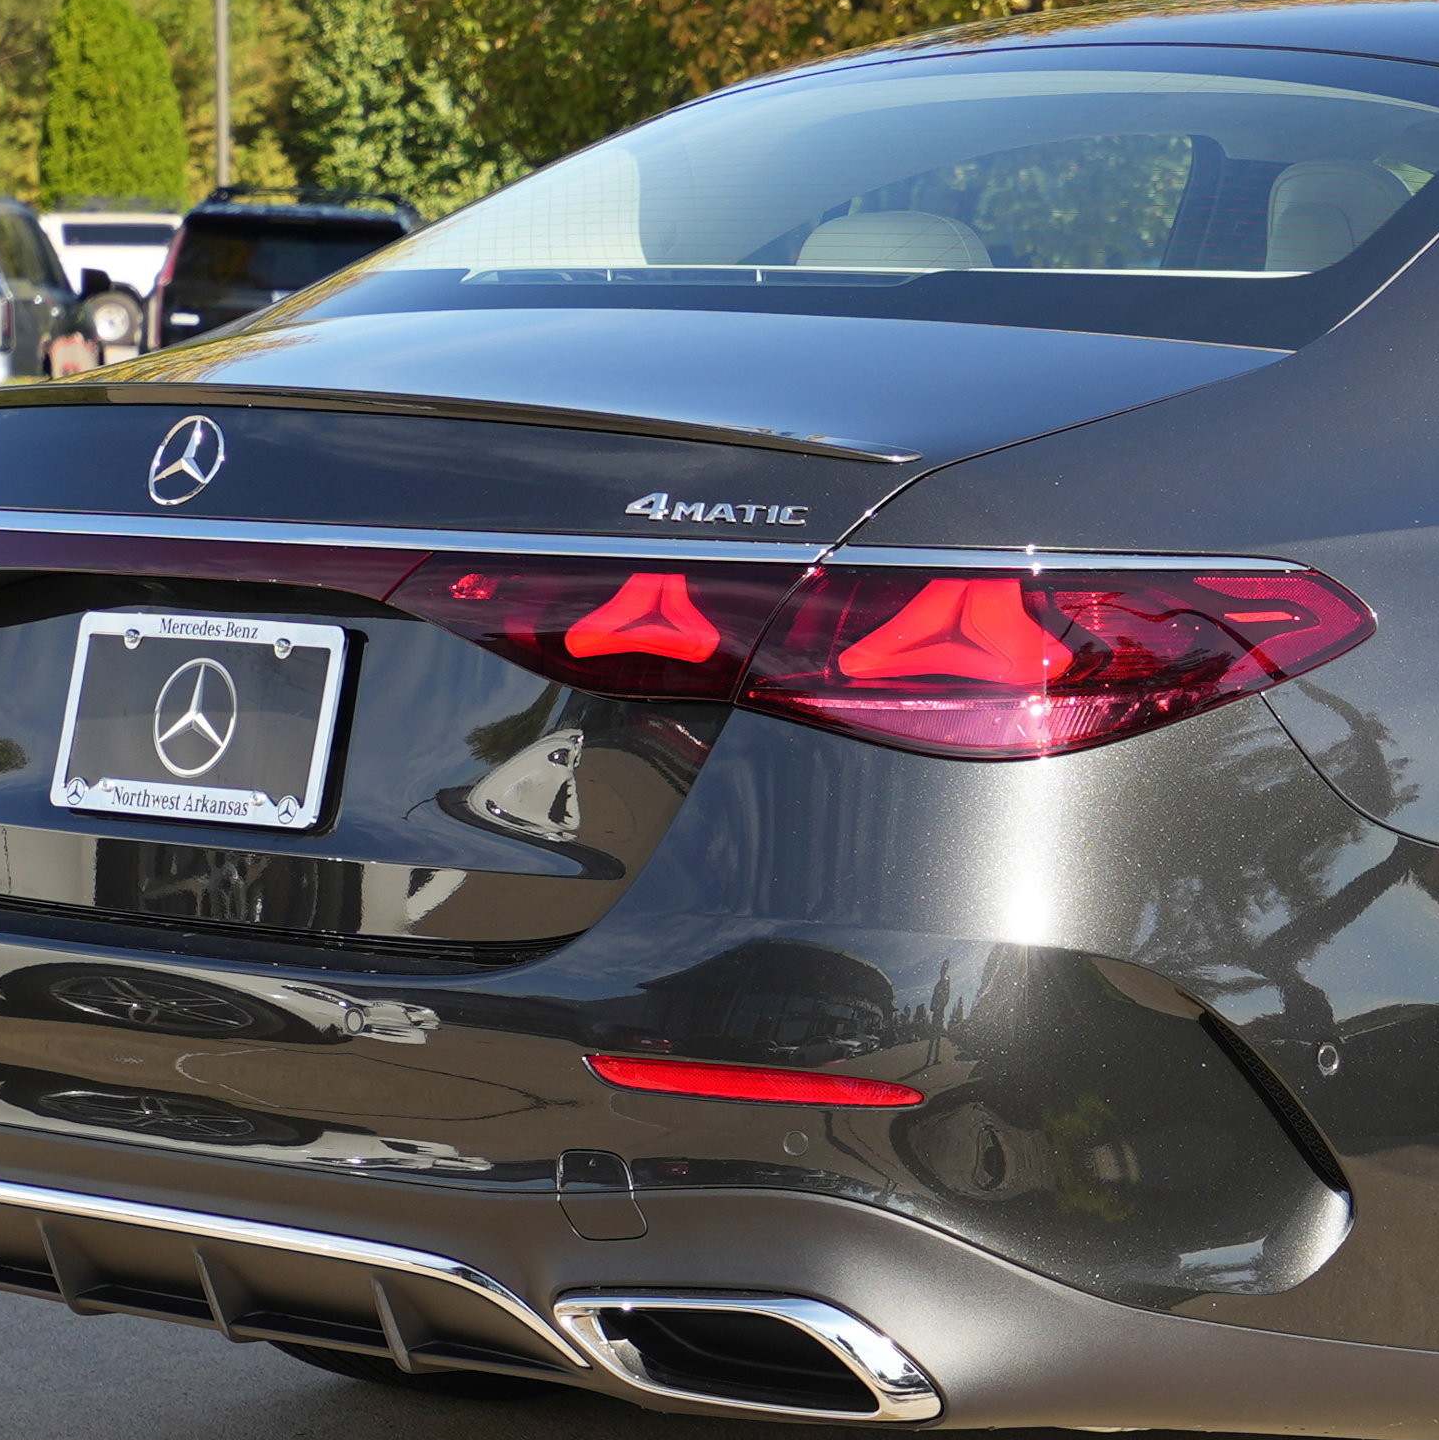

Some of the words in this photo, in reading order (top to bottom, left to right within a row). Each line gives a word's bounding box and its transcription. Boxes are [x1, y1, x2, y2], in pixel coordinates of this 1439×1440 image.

[625, 492, 809, 526] 4MATIC
[158, 617, 259, 640] Mercedes-Benz
[110, 785, 182, 811] Northwest
[183, 793, 250, 817] Arkansas
